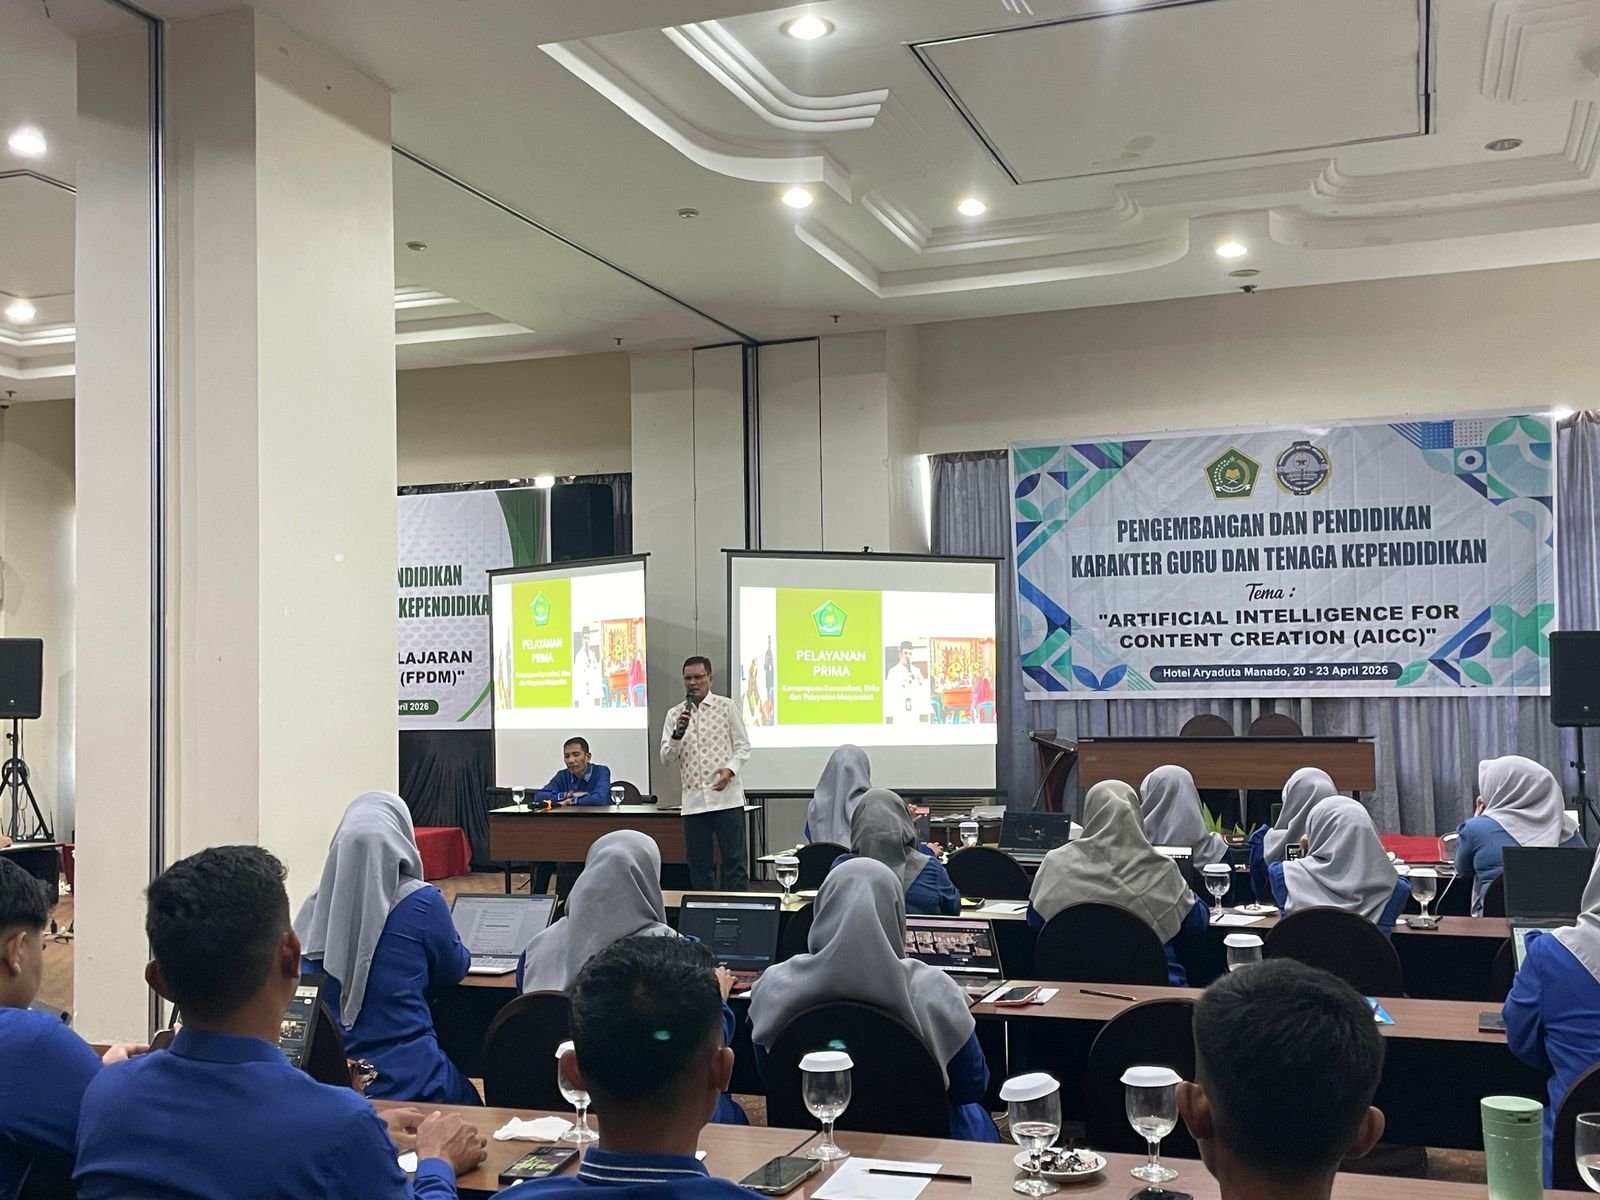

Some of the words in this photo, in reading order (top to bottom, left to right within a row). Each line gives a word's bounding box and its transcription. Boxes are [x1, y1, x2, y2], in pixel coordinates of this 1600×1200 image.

[1117, 512, 1265, 543] PENGEMBANGAN
[1270, 510, 1307, 536] DAN
[1313, 505, 1432, 534] PENDIDIKAN
[1071, 552, 1162, 578] KARAKTER
[1167, 549, 1217, 574] GURU
[1222, 547, 1260, 572] DAN
[1264, 544, 1338, 571] TENAGA
[1342, 538, 1487, 568] KEPENDIDIKAN
[1245, 583, 1285, 602] Tema
[1099, 610, 1229, 628] "ARTIFICIAL
[1236, 605, 1404, 625] INTELLIGENCE
[1411, 604, 1460, 620] FOR
[1119, 632, 1223, 649] CONTENT
[1230, 629, 1345, 647] CREATION
[1353, 627, 1437, 648] (AICC)"
[796, 650, 866, 661] PELAYANAN
[400, 670, 465, 688] (FPDM)"
[813, 665, 850, 677] PRIMA
[1163, 667, 1191, 678] Hotel
[1193, 667, 1241, 680] Aryaduta
[1244, 667, 1290, 678] Manado,
[1293, 666, 1306, 676] 20
[1317, 665, 1329, 676] 23
[1331, 665, 1359, 677] April
[1362, 665, 1389, 675] 2026
[409, 702, 429, 711] 2026
